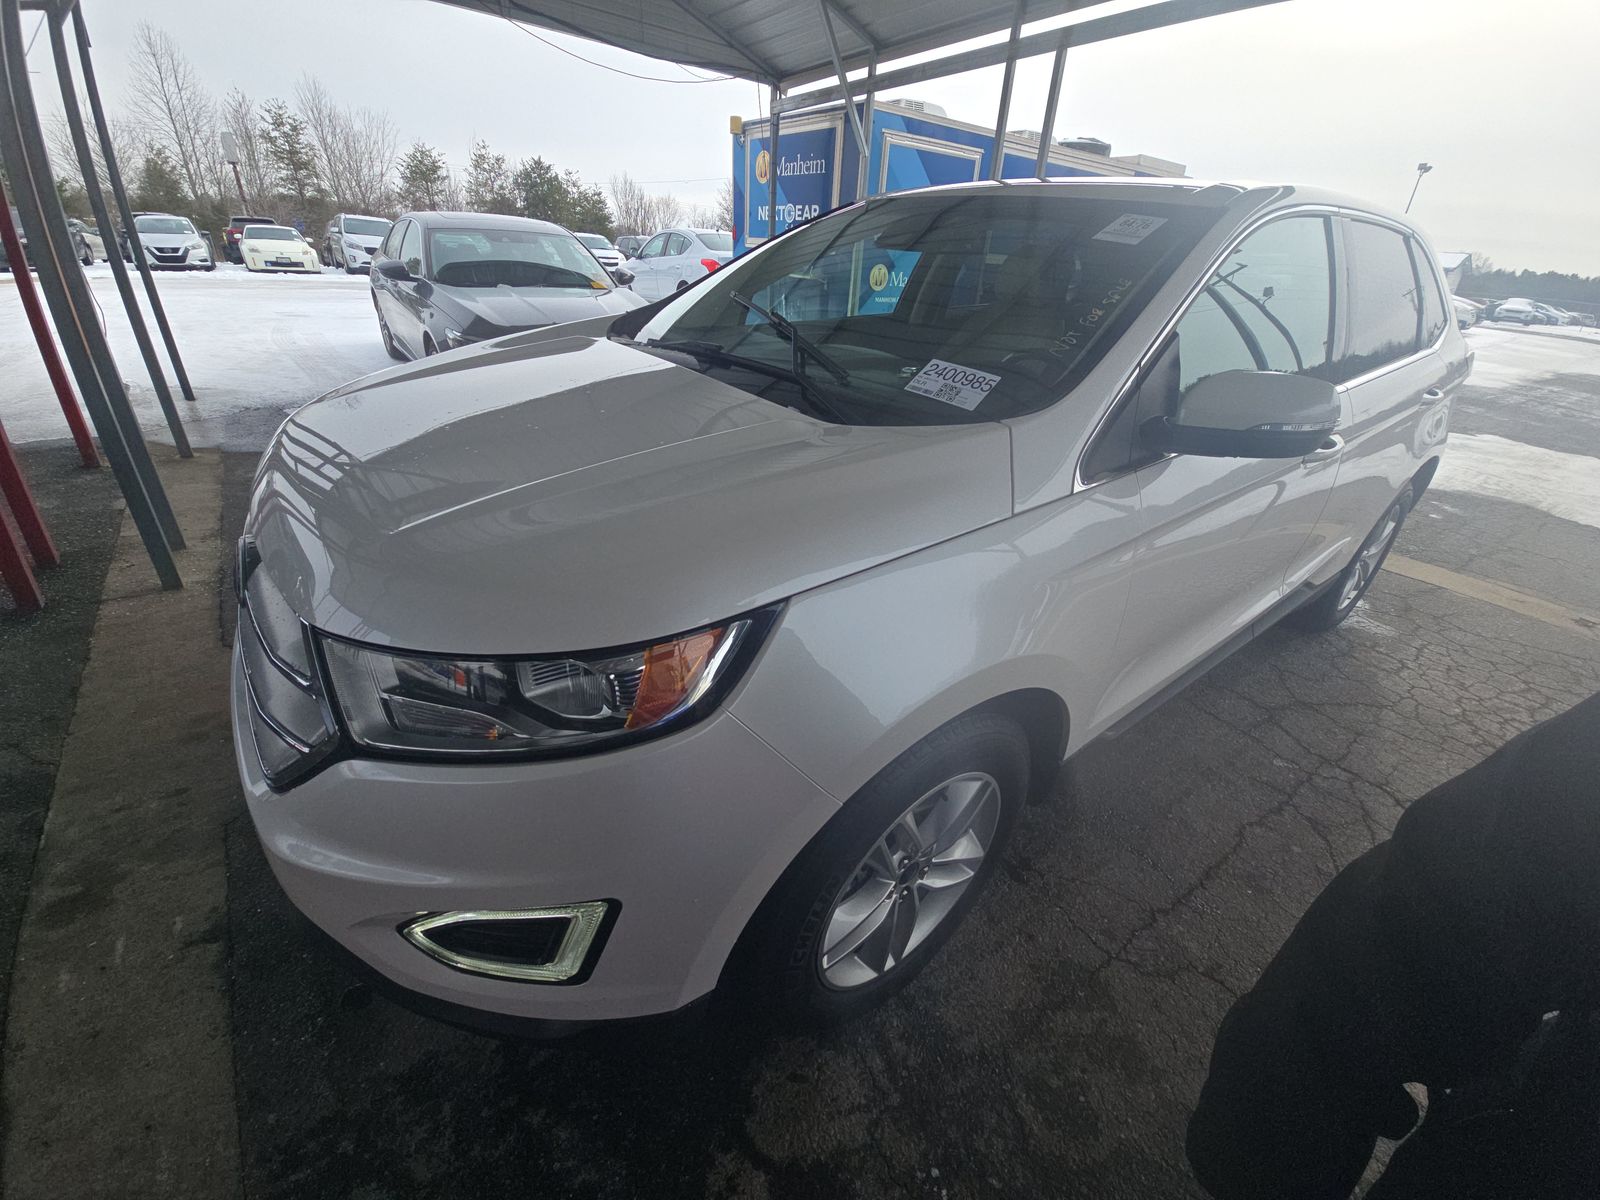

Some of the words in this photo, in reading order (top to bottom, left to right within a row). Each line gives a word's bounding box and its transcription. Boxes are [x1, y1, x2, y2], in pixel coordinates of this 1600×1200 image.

[777, 153, 826, 176] Manheim
[758, 203, 819, 222] NETGEAR
[922, 363, 997, 393] 2400985
